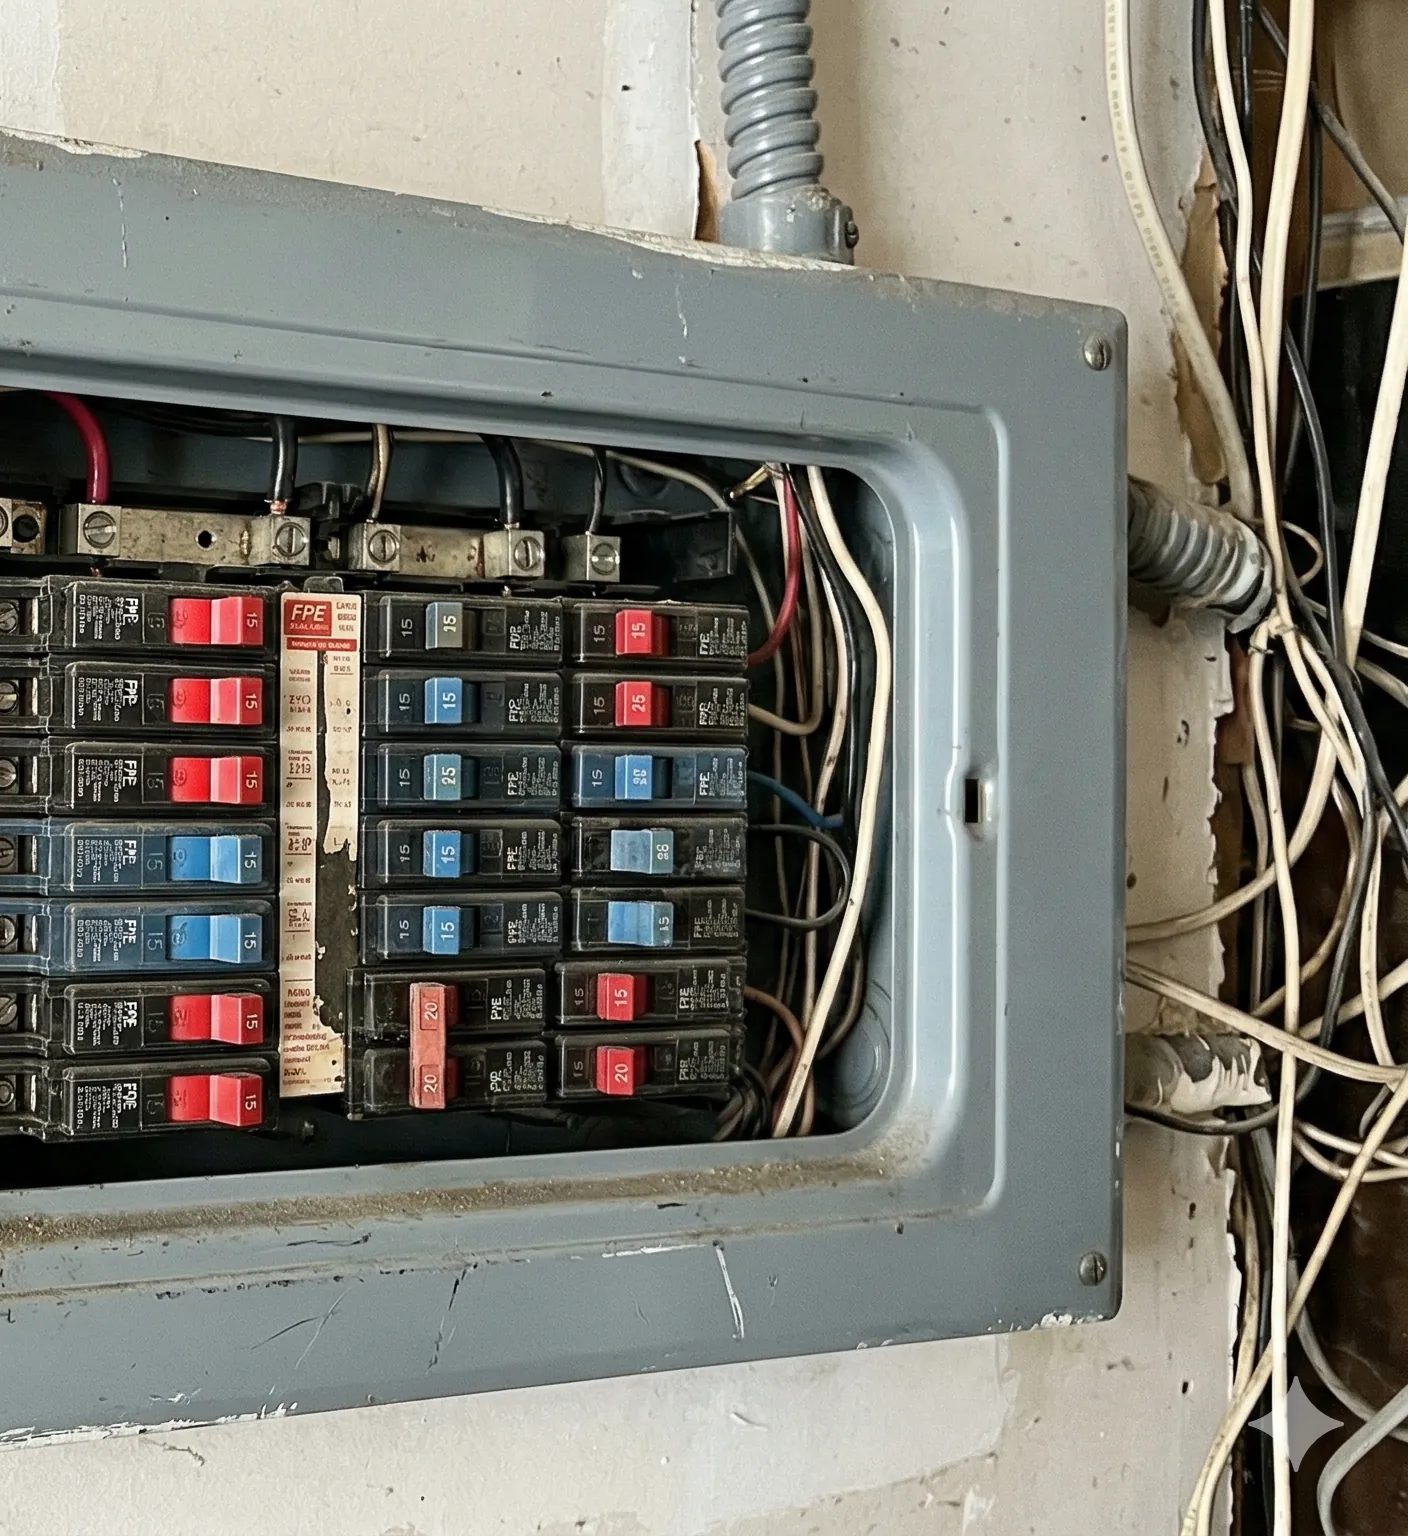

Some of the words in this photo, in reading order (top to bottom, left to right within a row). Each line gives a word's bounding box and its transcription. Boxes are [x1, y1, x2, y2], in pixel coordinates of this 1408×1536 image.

[246, 612, 259, 629] 15
[291, 604, 327, 622] FPE
[632, 622, 647, 640] 15
[245, 692, 259, 710] 15
[442, 691, 458, 711] 15
[632, 693, 647, 713] 25
[245, 770, 259, 790] 15
[441, 766, 458, 786] 25
[147, 852, 163, 871] 15
[244, 852, 258, 870] 15
[441, 846, 457, 866] 15
[147, 932, 163, 950] 15
[244, 931, 258, 949] 15
[441, 921, 457, 942] 15
[614, 989, 628, 1007] 15
[424, 1001, 439, 1021] 20
[246, 1012, 259, 1030] 15
[615, 1064, 629, 1083] 20
[424, 1073, 439, 1094] 20
[245, 1092, 258, 1111] 15
